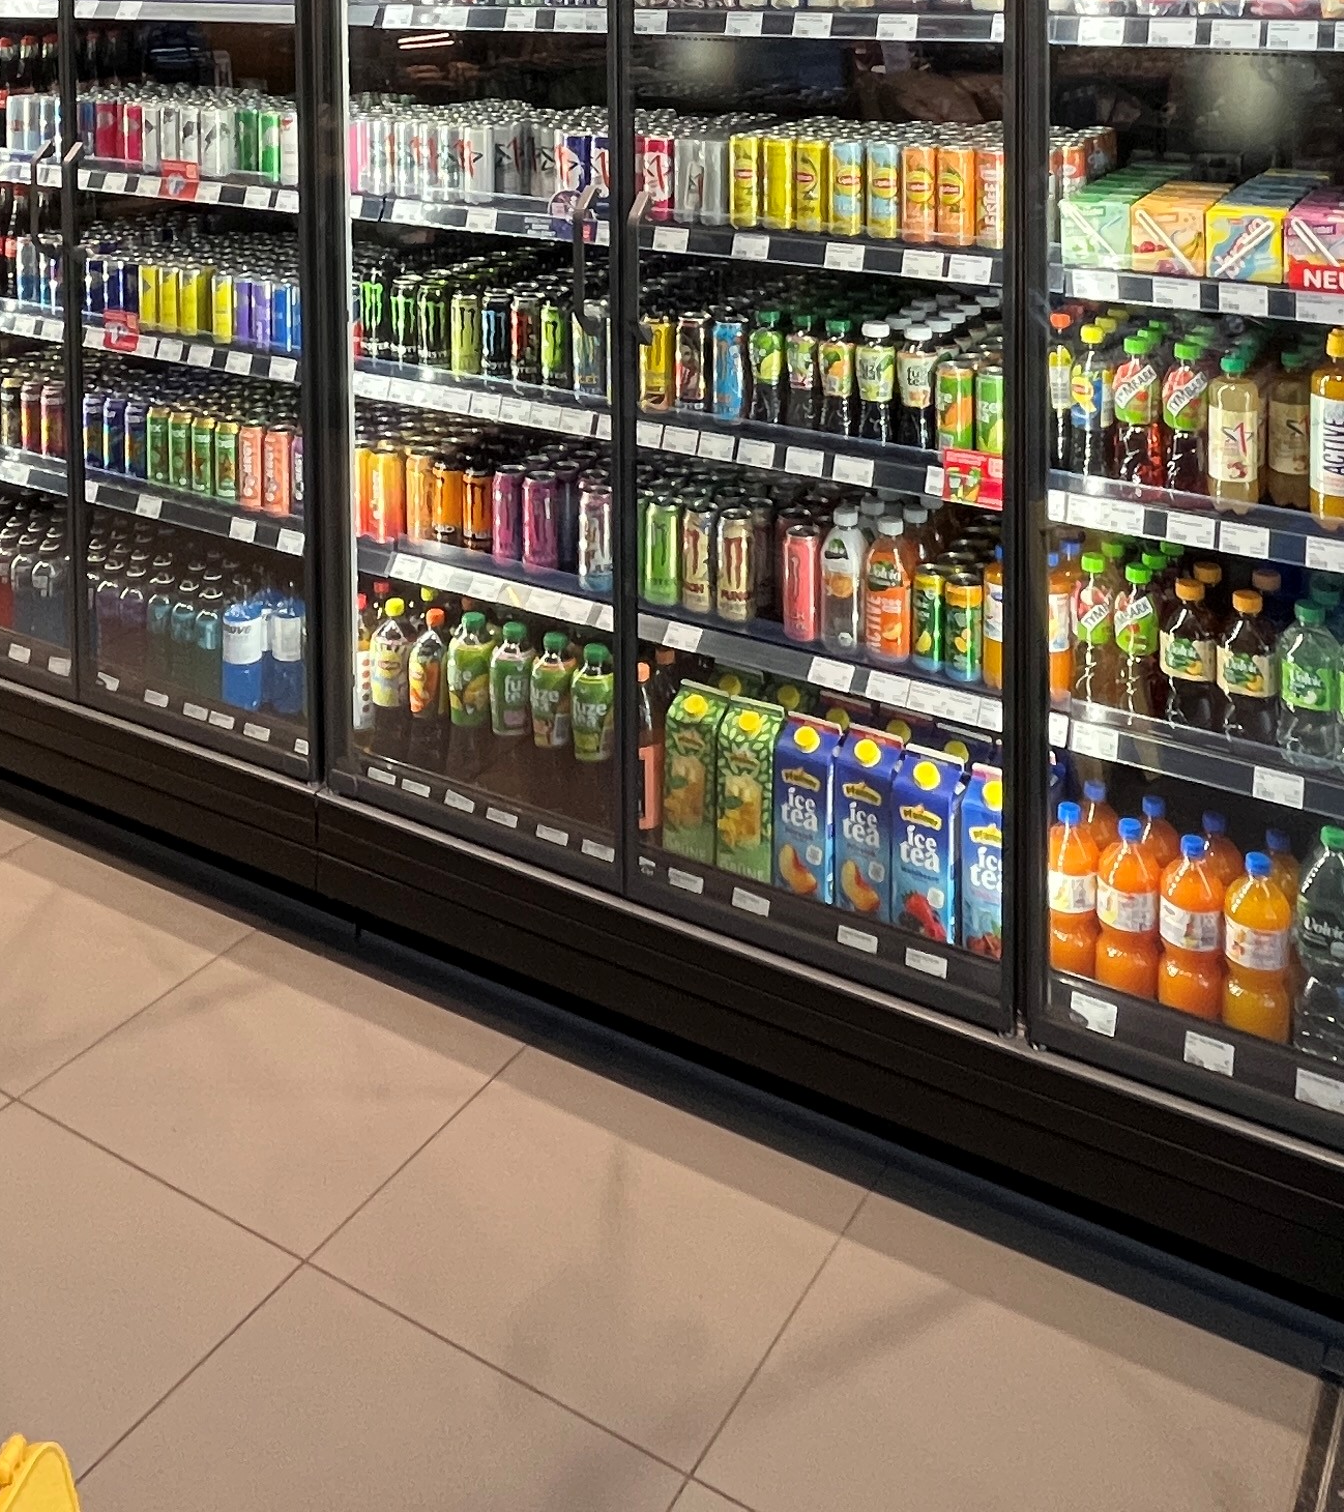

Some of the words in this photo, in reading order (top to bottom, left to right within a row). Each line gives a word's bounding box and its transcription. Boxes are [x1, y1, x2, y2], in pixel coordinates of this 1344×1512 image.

[787, 787, 816, 814] ice
[781, 802, 818, 832] tea
[849, 801, 878, 830] ice
[842, 816, 881, 849] tea
[906, 824, 937, 853] ice
[899, 839, 941, 874] tea
